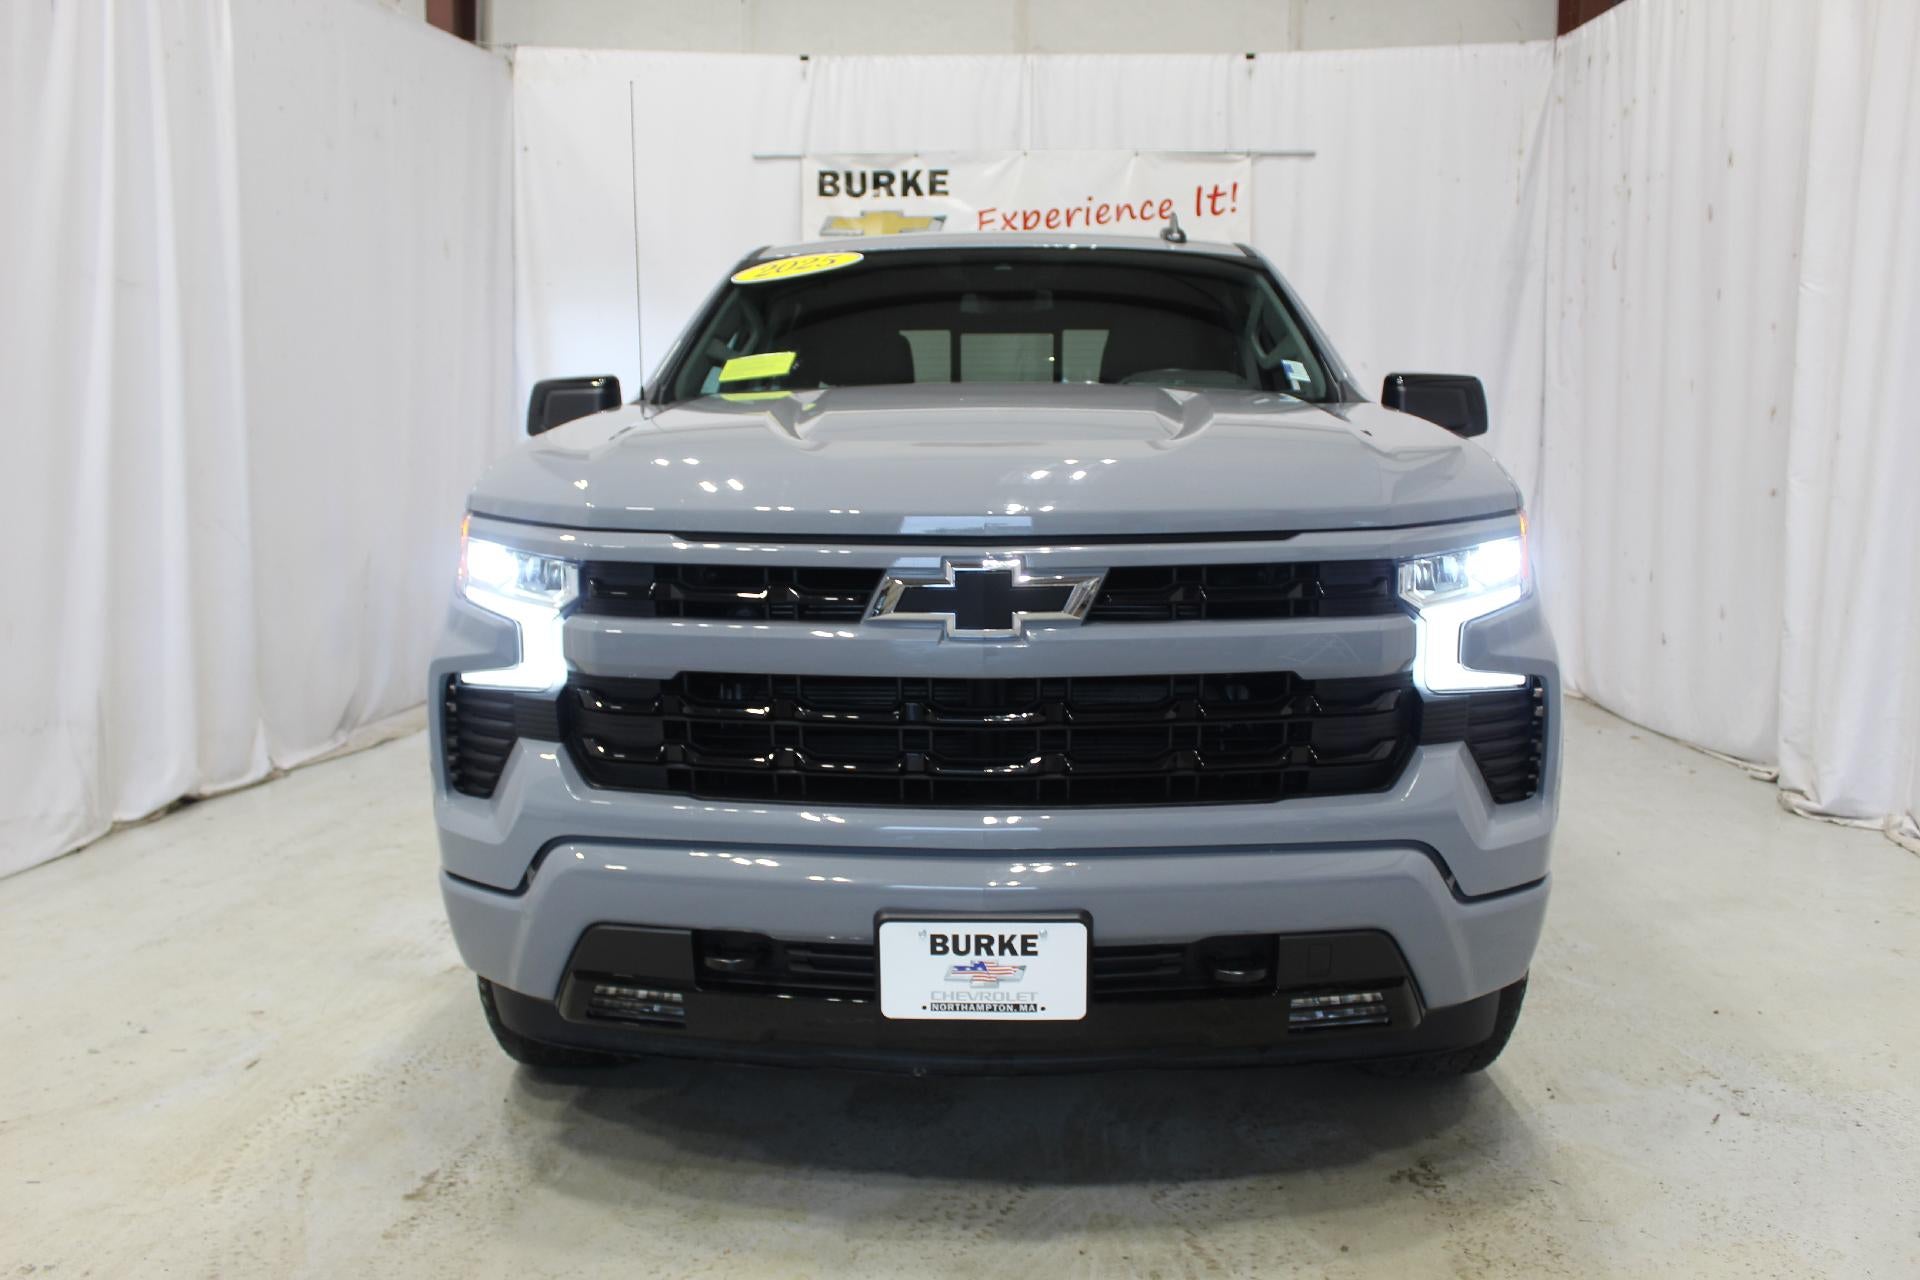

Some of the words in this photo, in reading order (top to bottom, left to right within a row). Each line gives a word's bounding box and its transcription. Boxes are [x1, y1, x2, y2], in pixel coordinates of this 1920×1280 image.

[818, 169, 949, 198] BURKE
[977, 196, 1174, 231] Experience
[1195, 182, 1239, 217] It!
[754, 254, 842, 278] 2025
[929, 934, 1039, 956] BURKE
[930, 991, 1039, 1002] CHEVROLET
[1019, 1003, 1037, 1012] MA
